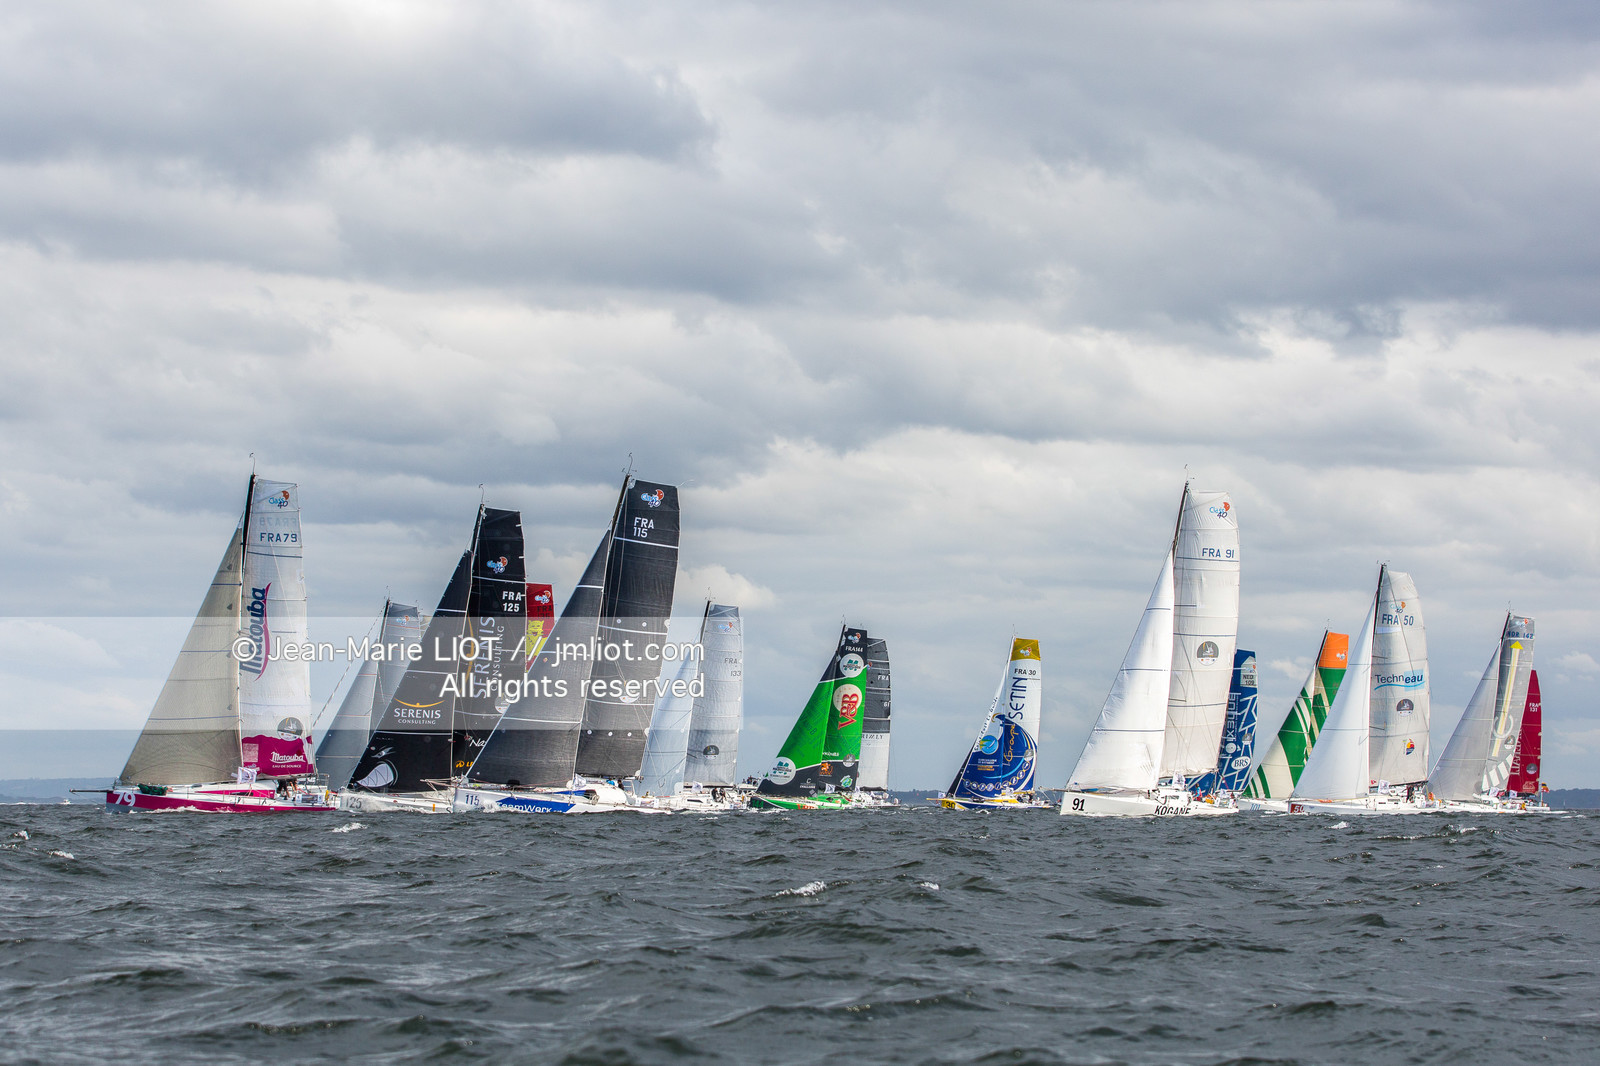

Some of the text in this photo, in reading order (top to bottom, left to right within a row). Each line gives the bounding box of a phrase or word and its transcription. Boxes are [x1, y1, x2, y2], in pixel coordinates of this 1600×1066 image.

[1217, 511, 1228, 519] 40
[633, 516, 654, 530] FRA
[259, 532, 298, 543] FRA79
[633, 526, 648, 538] 115
[1202, 547, 1235, 559] FRA 91
[502, 591, 522, 601] FRA
[502, 602, 520, 612] 125
[1382, 613, 1414, 626] FRA 50
[1014, 667, 1027, 675] FRA
[1375, 673, 1424, 684] Techneau
[1007, 676, 1028, 720] SETIN
[393, 707, 442, 719] SERENIS
[270, 751, 307, 763] Matouba
[1234, 759, 1249, 767] BRS
[113, 791, 136, 807] 79
[465, 794, 480, 806] 115
[1071, 798, 1085, 812] 91
